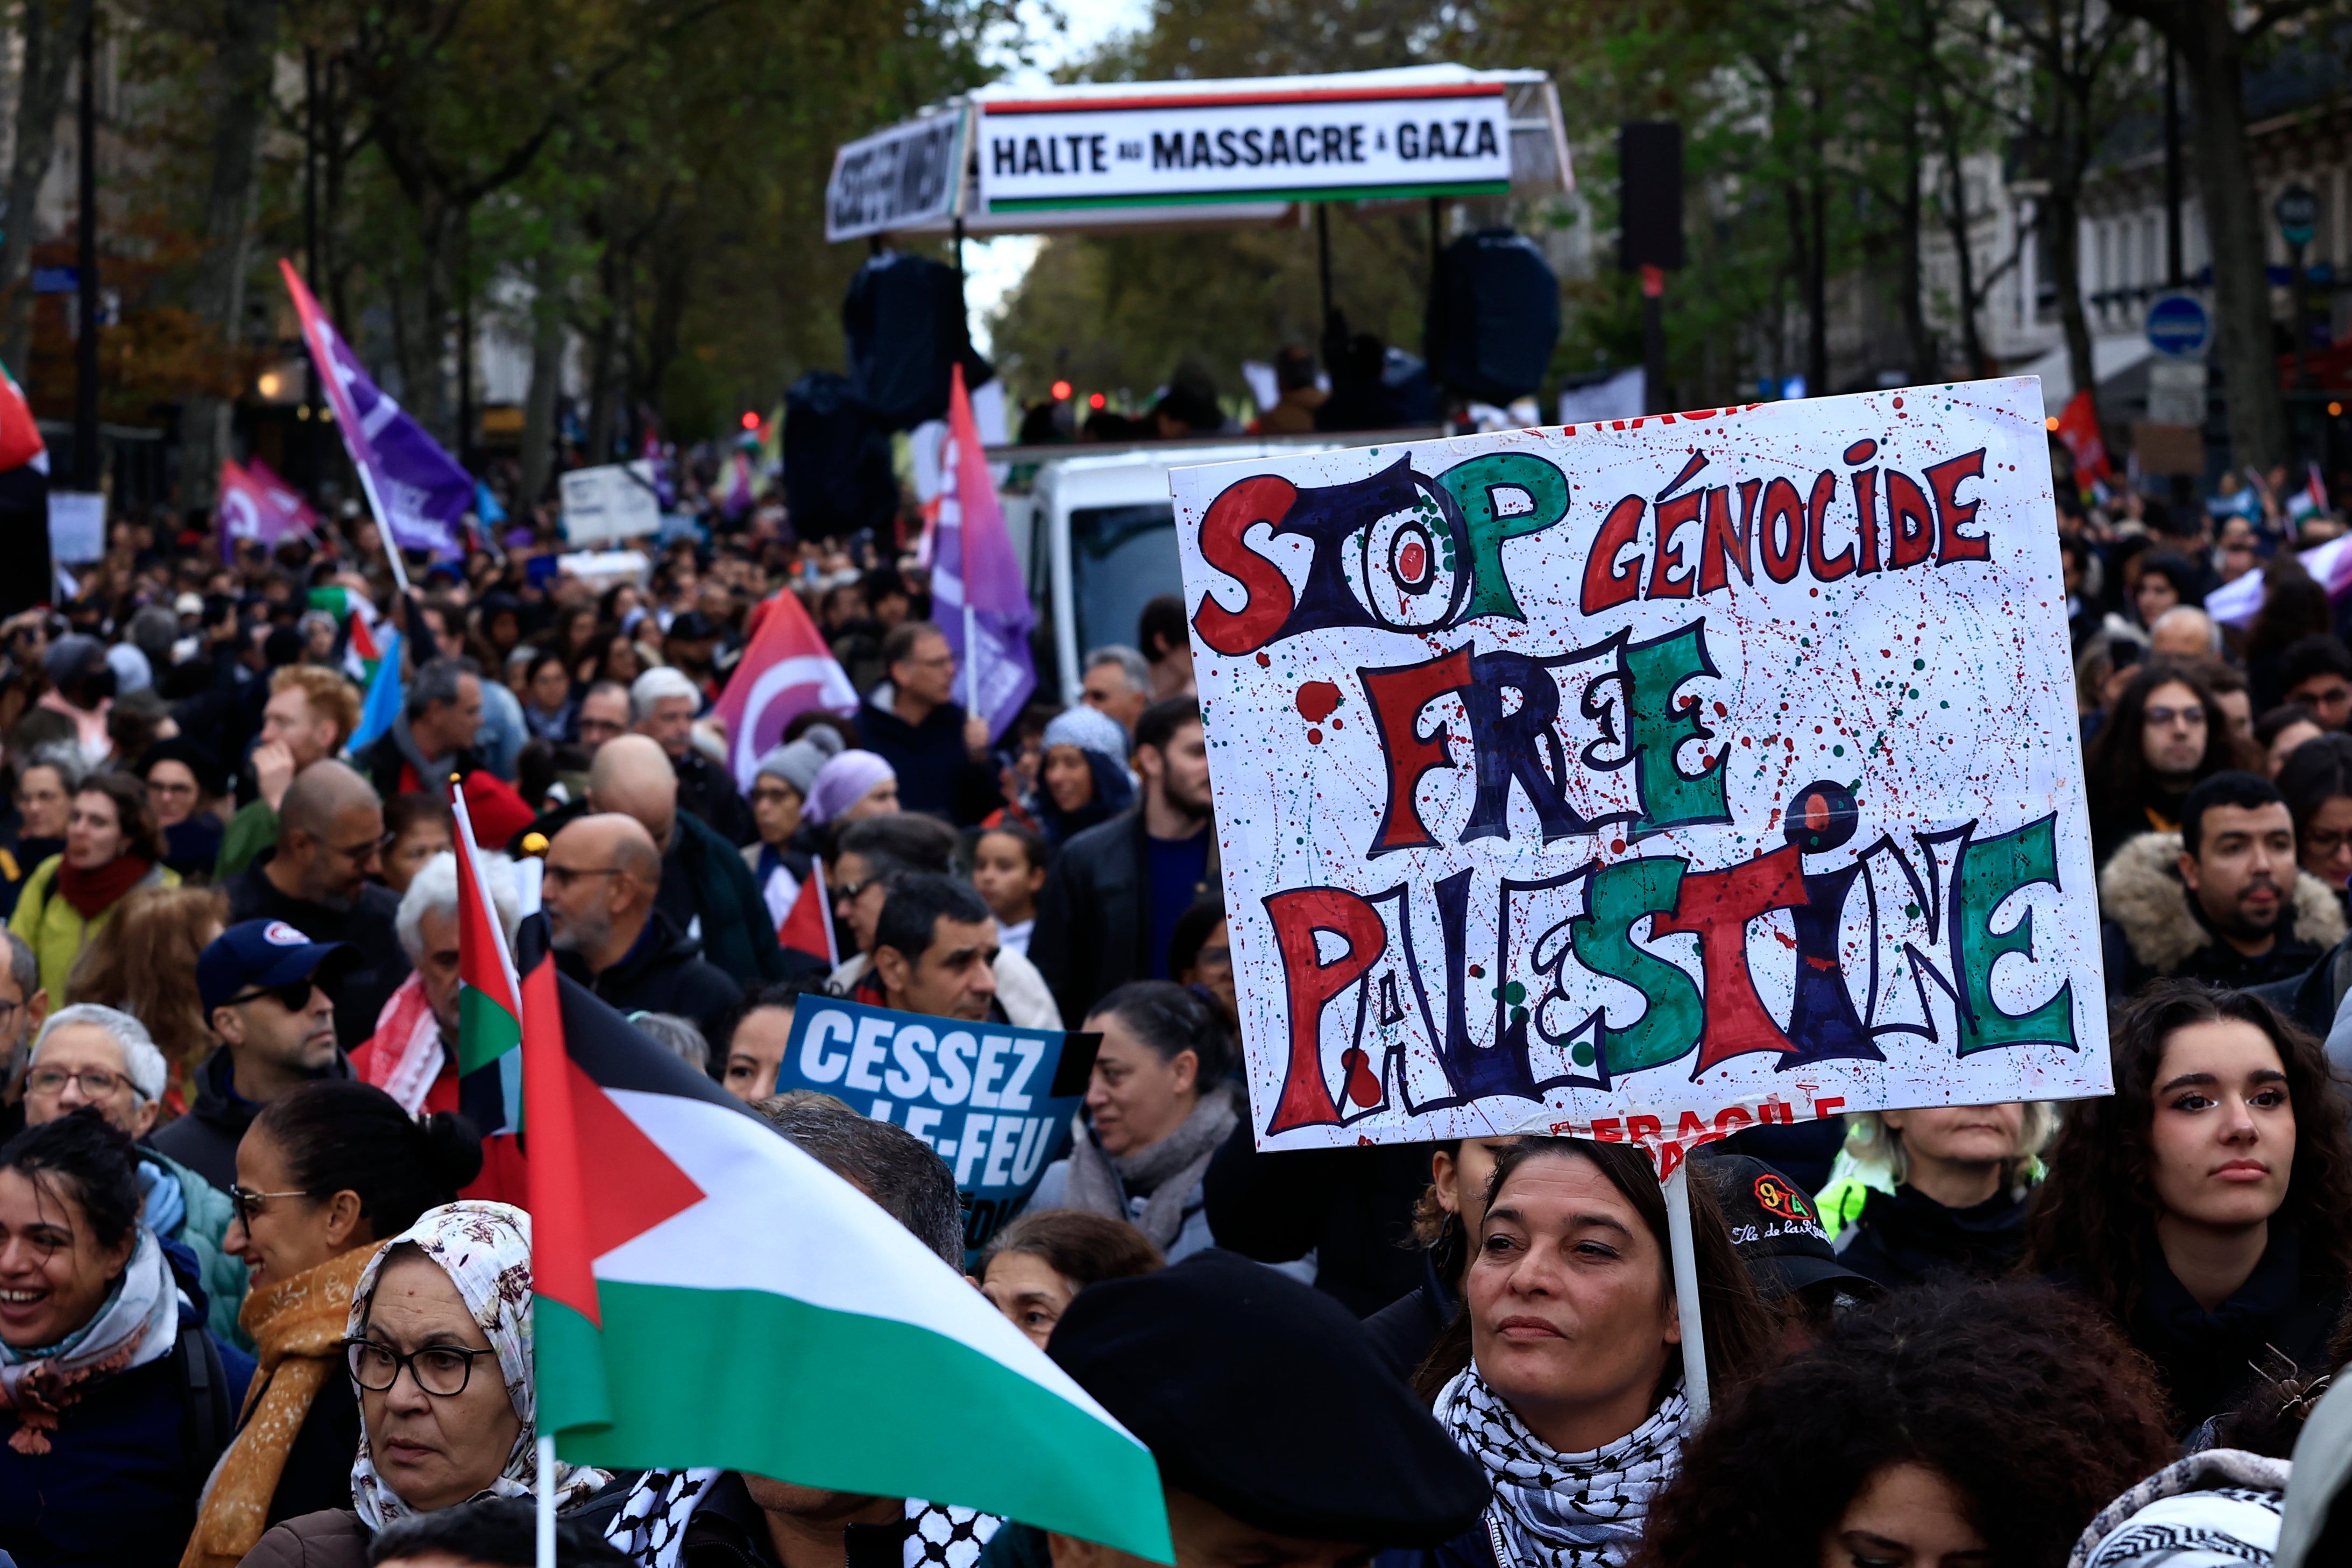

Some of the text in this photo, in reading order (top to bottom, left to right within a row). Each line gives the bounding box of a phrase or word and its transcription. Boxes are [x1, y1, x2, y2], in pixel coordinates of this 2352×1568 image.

[994, 133, 1108, 175] HALTE
[1153, 125, 1366, 169] MASSACRE
[1398, 120, 1498, 159] GAZA
[1192, 451, 1570, 657] STOP
[1356, 617, 1734, 860] FREE
[799, 1009, 1046, 1111] CESSEZ
[1760, 1183, 1810, 1217] 974
[1764, 1222, 1783, 1238] de
